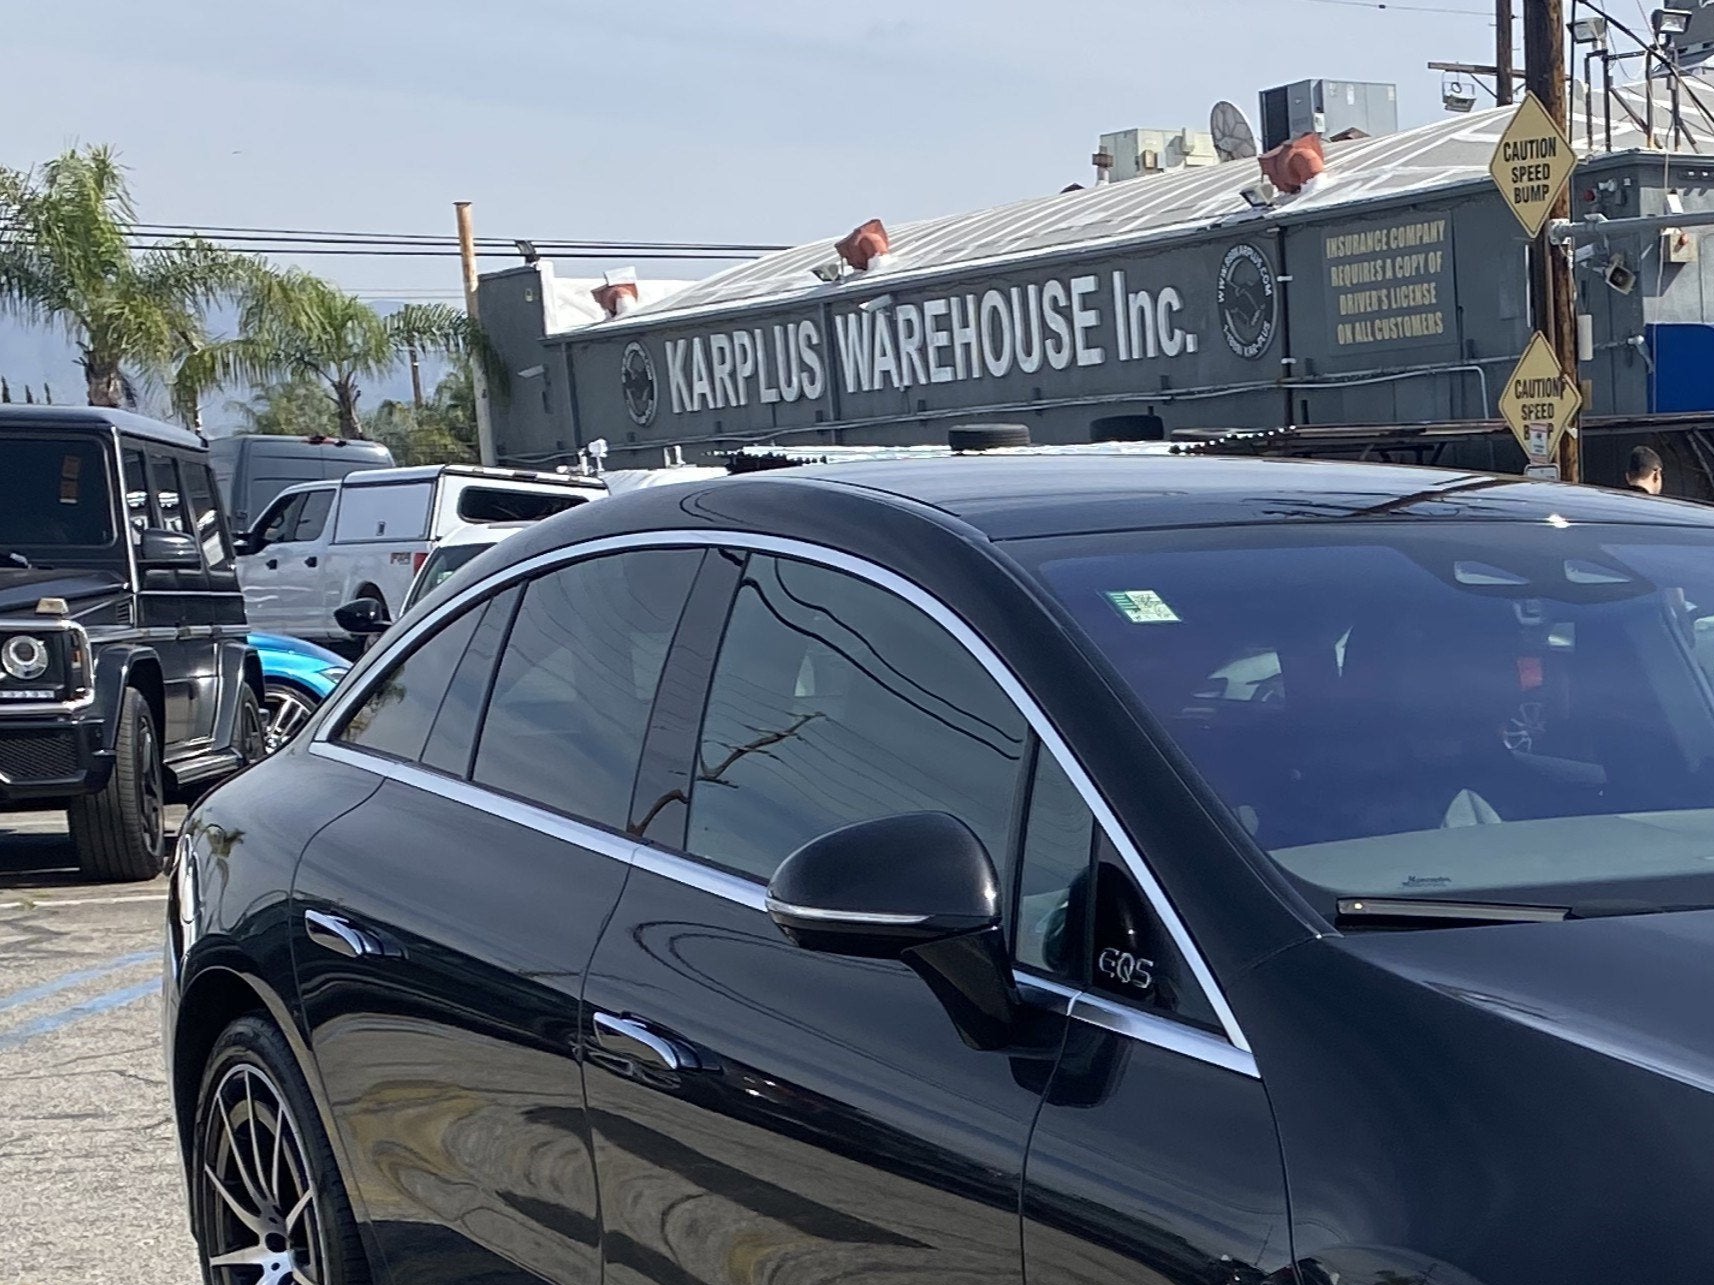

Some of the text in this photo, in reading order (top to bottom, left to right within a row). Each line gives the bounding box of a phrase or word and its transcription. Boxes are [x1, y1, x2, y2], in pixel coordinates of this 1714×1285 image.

[1503, 137, 1557, 162] CAUTION
[1511, 163, 1551, 184] SPEED
[1514, 184, 1550, 204] BUMP
[1326, 219, 1446, 259] INSURANCE COMPANY
[1330, 250, 1443, 287] REQUIRES A COPY OF
[1340, 282, 1437, 316] DRIVER'S LICENSE
[665, 319, 826, 414] KARPLUS
[834, 274, 1106, 394] WAREHOUSE
[1112, 270, 1199, 361] Inc.
[1337, 311, 1444, 345] ON ALL CUSTOMERS
[1514, 376, 1561, 400] CAUTION
[1521, 402, 1555, 421] SPEED
[1523, 422, 1555, 441] BP
[1099, 947, 1154, 989] EQS
